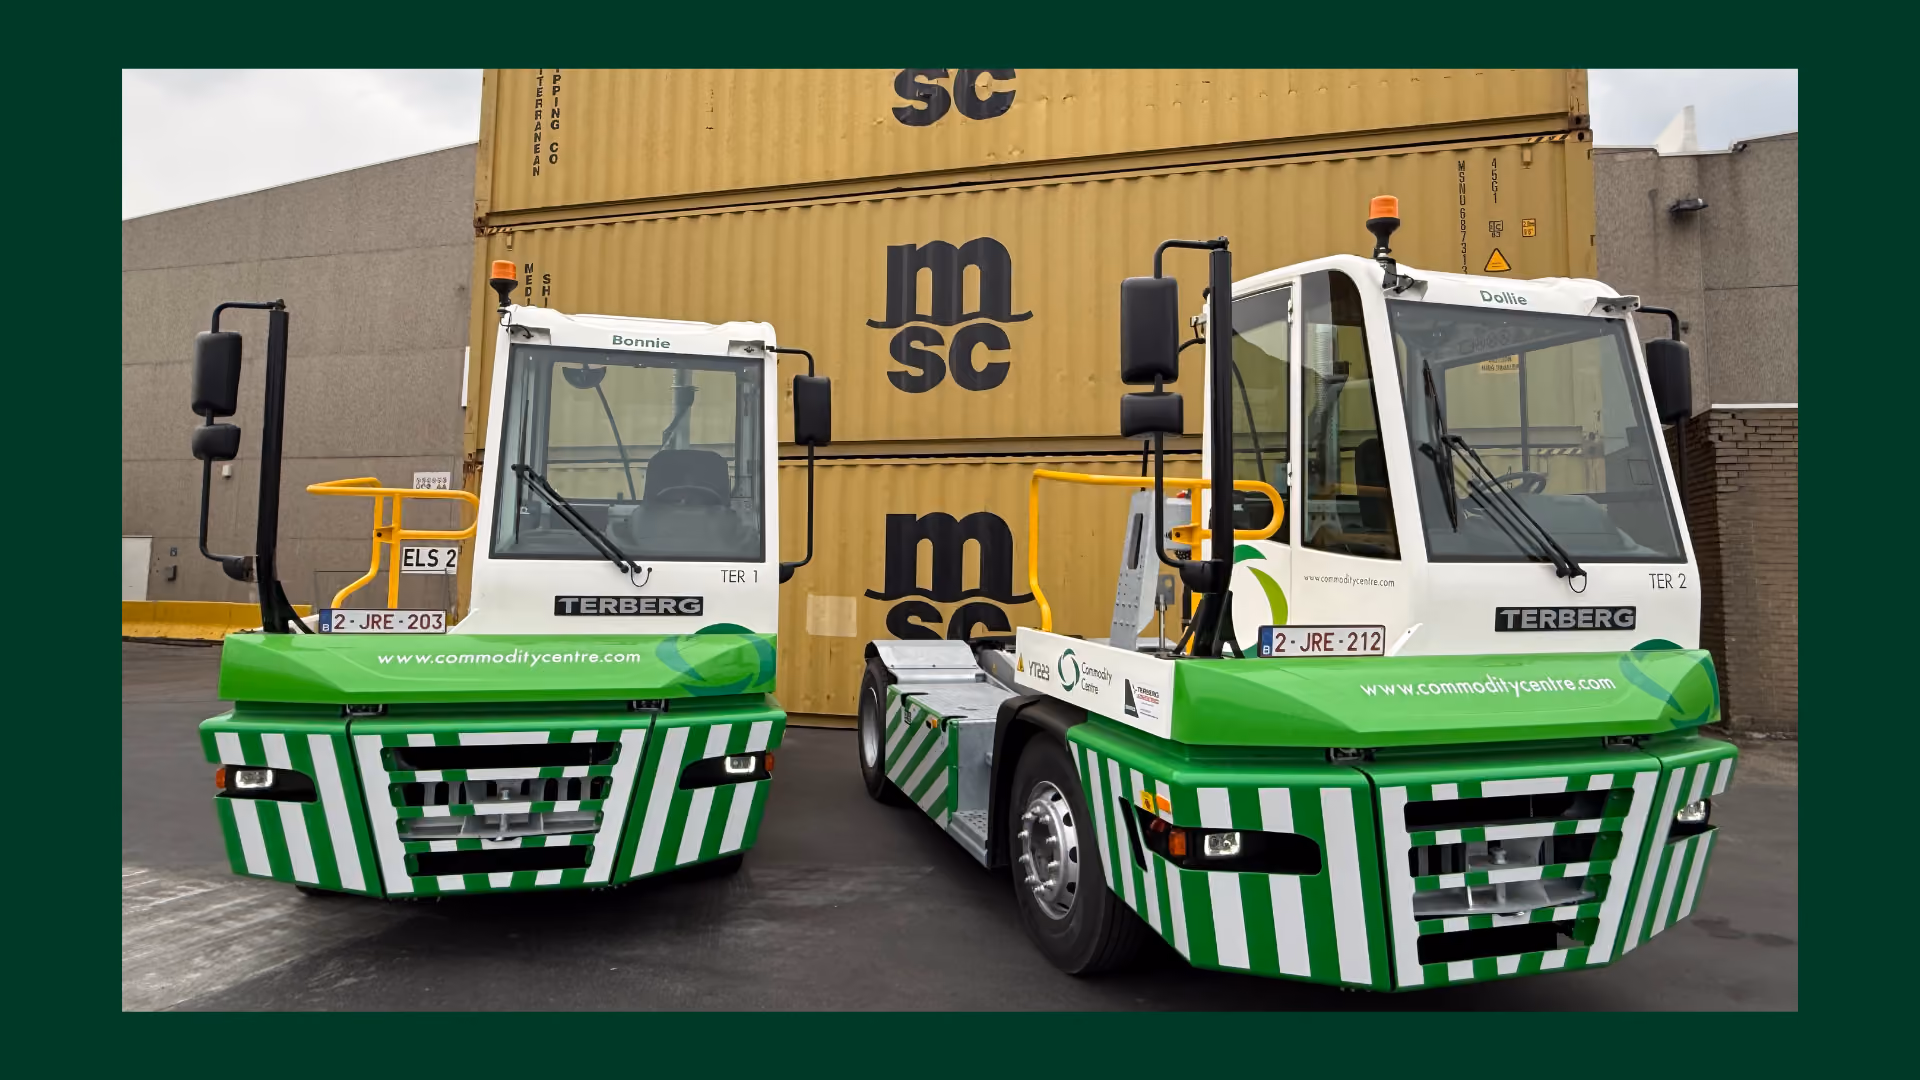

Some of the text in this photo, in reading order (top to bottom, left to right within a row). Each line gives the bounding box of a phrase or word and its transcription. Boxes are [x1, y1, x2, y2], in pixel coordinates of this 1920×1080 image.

[549, 142, 559, 164] CO
[1480, 290, 1528, 306] Dollie
[612, 335, 671, 349] Bonnie
[403, 548, 457, 568] ELS 2
[721, 569, 758, 583] TER 1
[1303, 574, 1395, 588] www.commoditycentre.com
[1649, 573, 1688, 590] TER 2
[558, 597, 701, 614] TERBERG
[1500, 608, 1635, 630] TERBERG
[378, 649, 641, 667] www.commoditycentre.com
[1262, 645, 1270, 654] B
[1081, 662, 1113, 685] Commodity
[1081, 678, 1099, 695] Centre
[1360, 674, 1617, 698] www.commoditycentre.com
